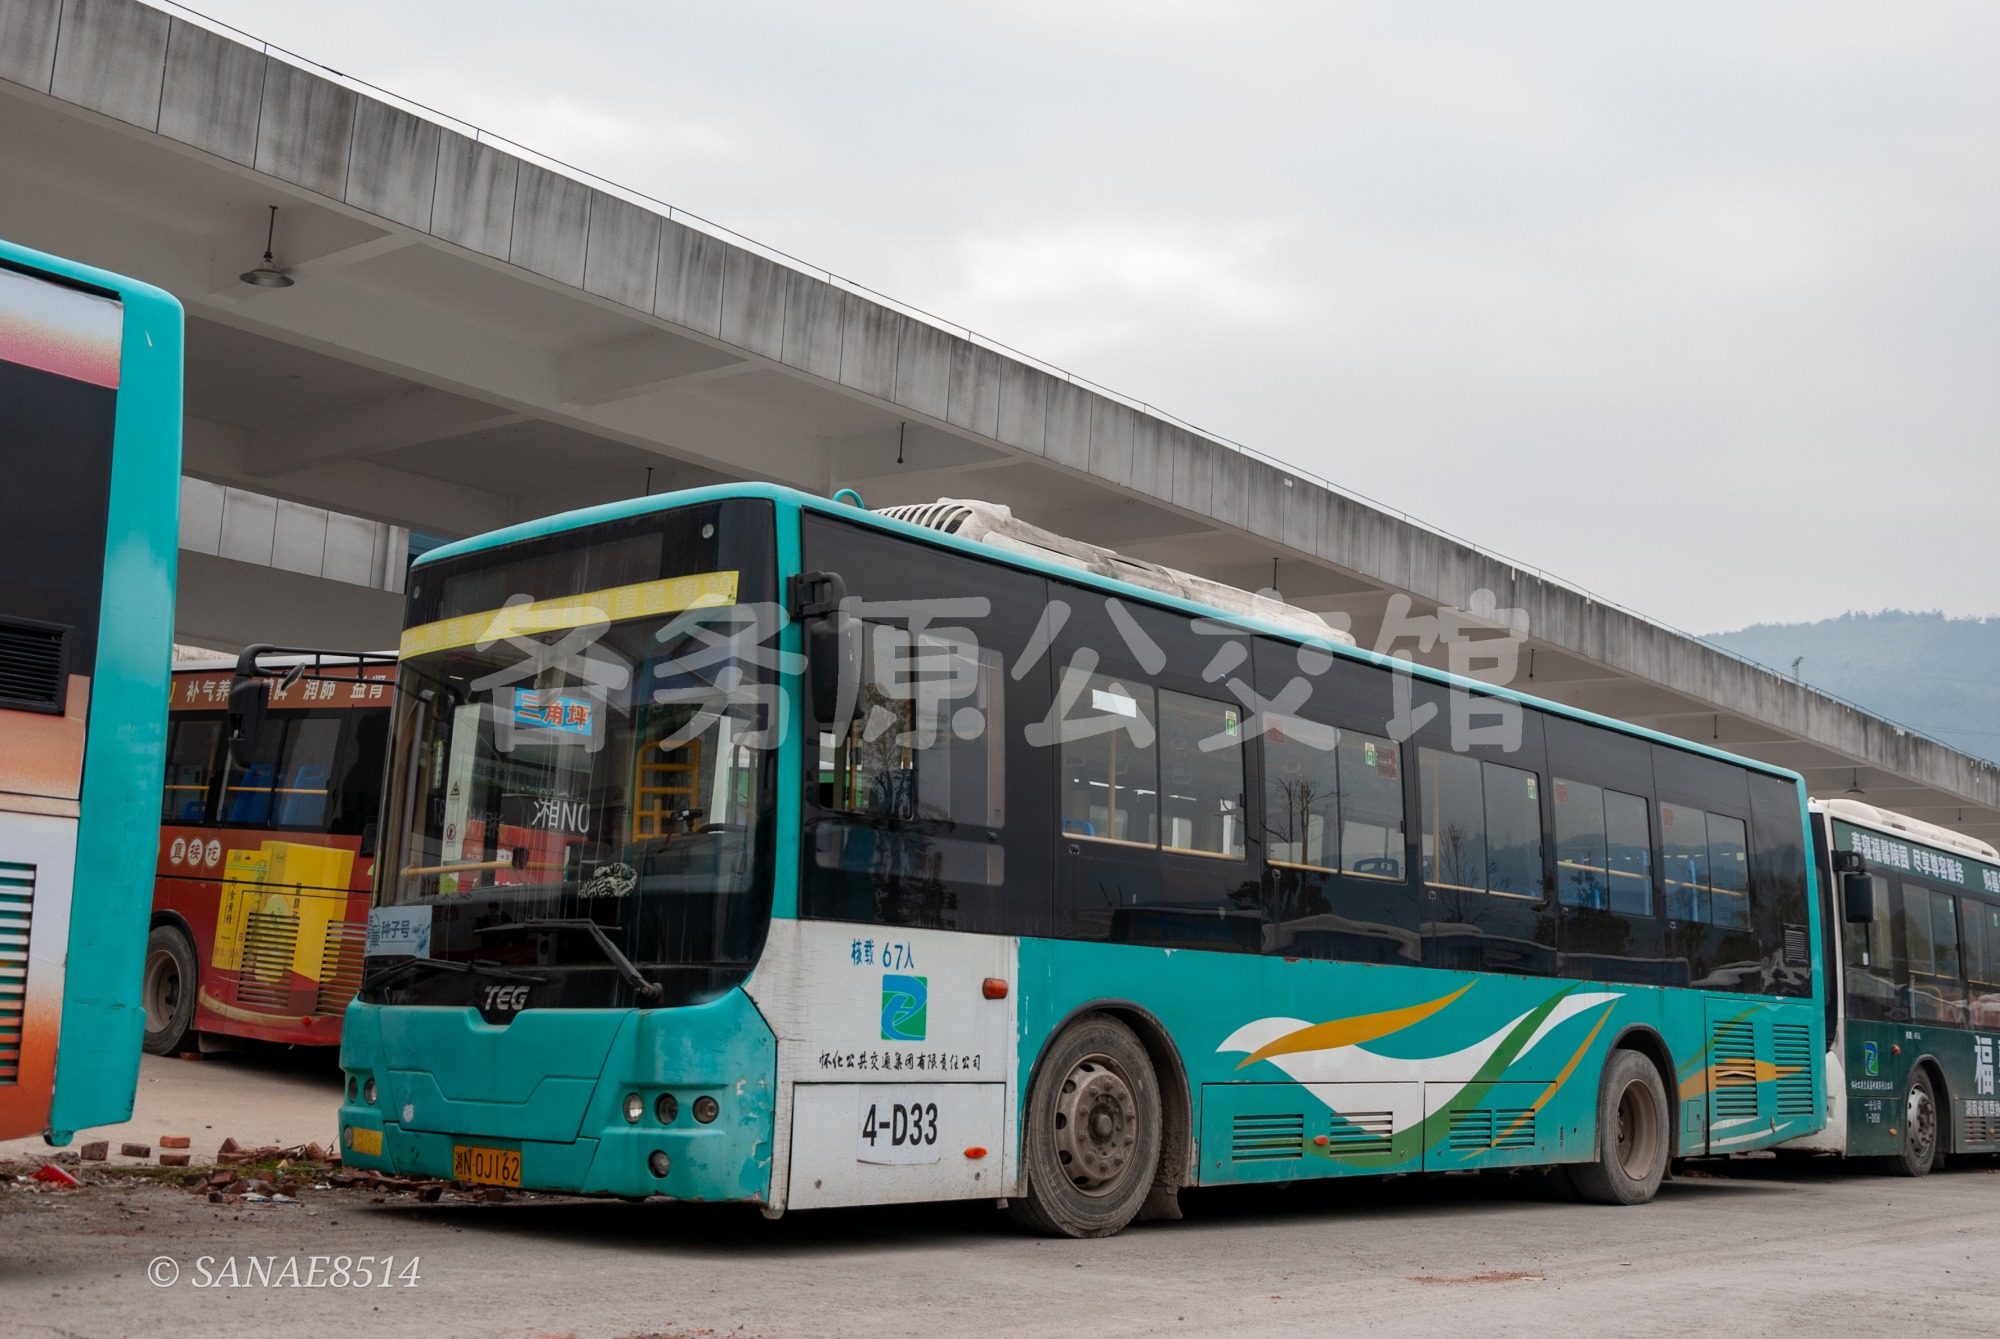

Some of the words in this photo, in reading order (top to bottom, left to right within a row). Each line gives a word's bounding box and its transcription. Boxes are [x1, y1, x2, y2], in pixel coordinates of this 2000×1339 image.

[170, 841, 219, 863] 直接吃
[381, 920, 411, 939] 种子号
[851, 938, 875, 966] 核载
[882, 942, 914, 970] 67人
[484, 985, 531, 1011] TEG
[819, 1049, 982, 1071] 怀化公共交通集团有限责任公司
[862, 1103, 938, 1146] 4-D33
